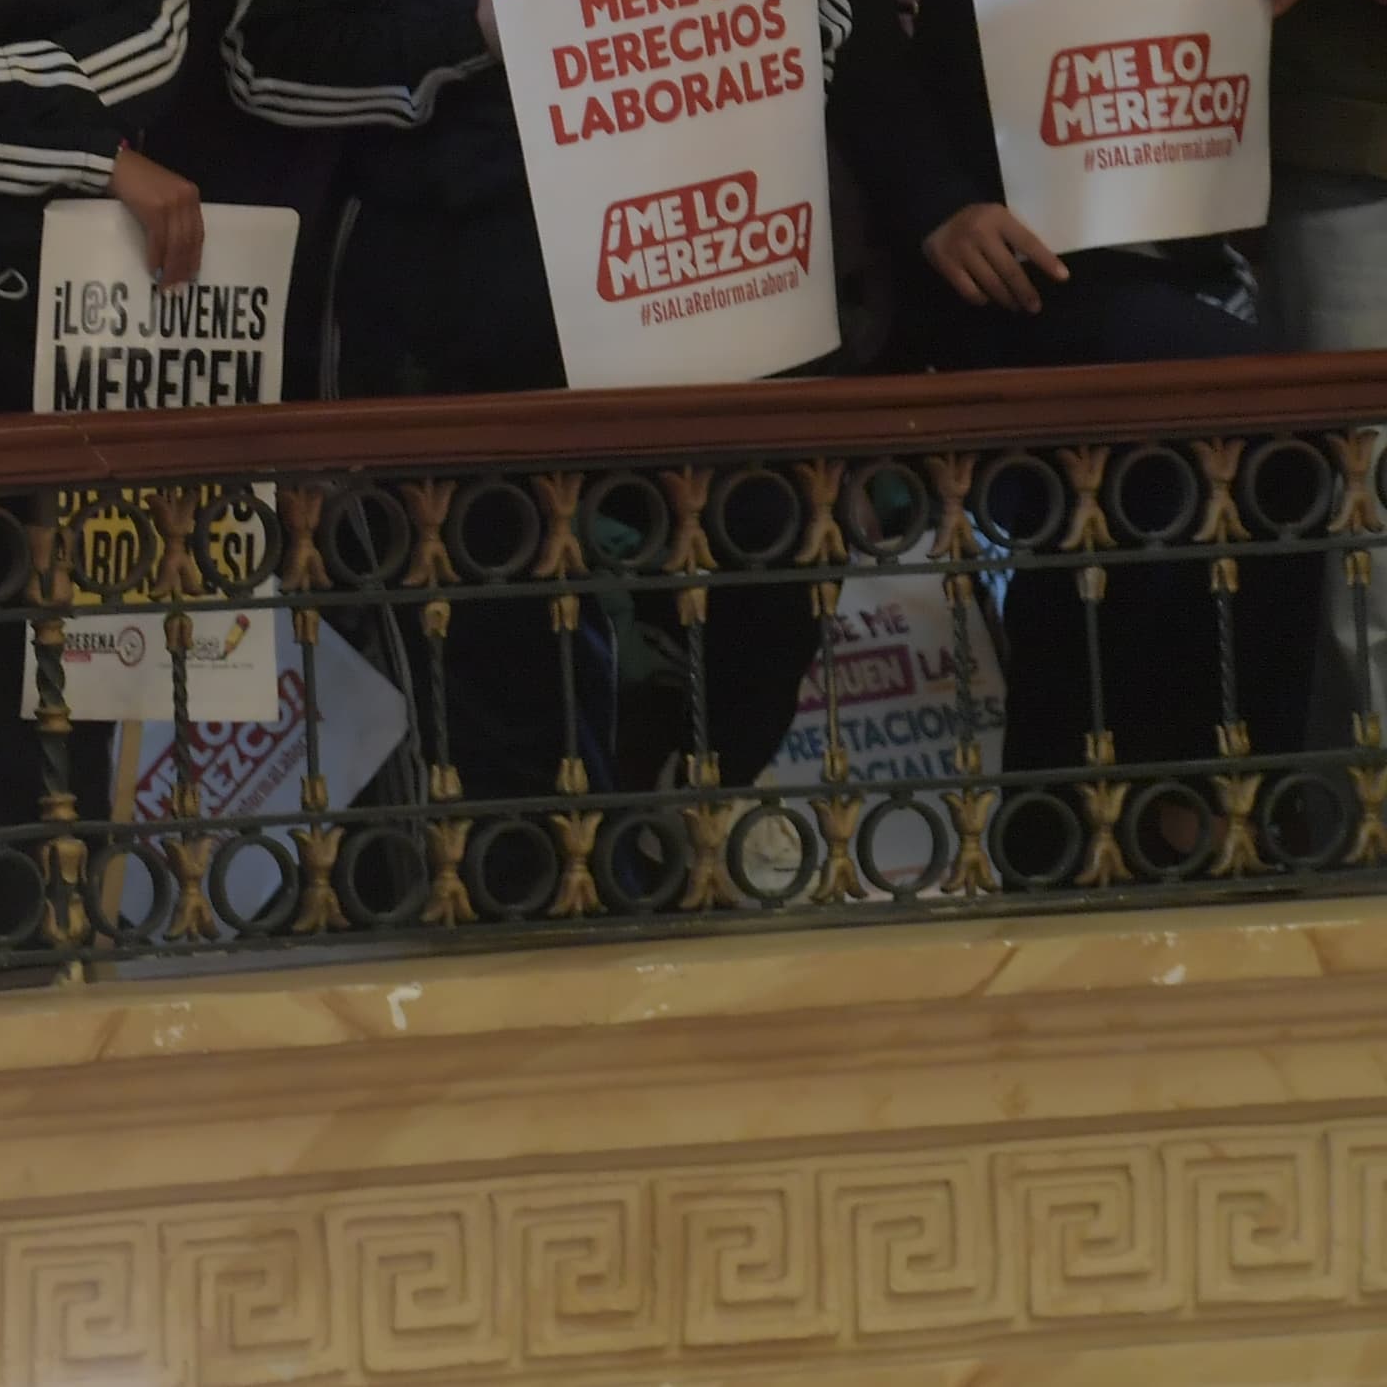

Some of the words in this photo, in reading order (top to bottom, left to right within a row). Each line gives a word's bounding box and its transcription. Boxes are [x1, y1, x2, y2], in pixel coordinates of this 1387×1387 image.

[549, 47, 805, 146] LABORALES
[1053, 49, 1137, 95] ¡ME
[1148, 39, 1203, 84] LO
[1051, 80, 1248, 143] MEREZCO!
[607, 201, 685, 251] ¡ME
[692, 181, 749, 230] LO
[606, 209, 812, 297] MEREZCO!
[54, 281, 128, 340] ¡L@S
[54, 345, 262, 411] MERECEN
